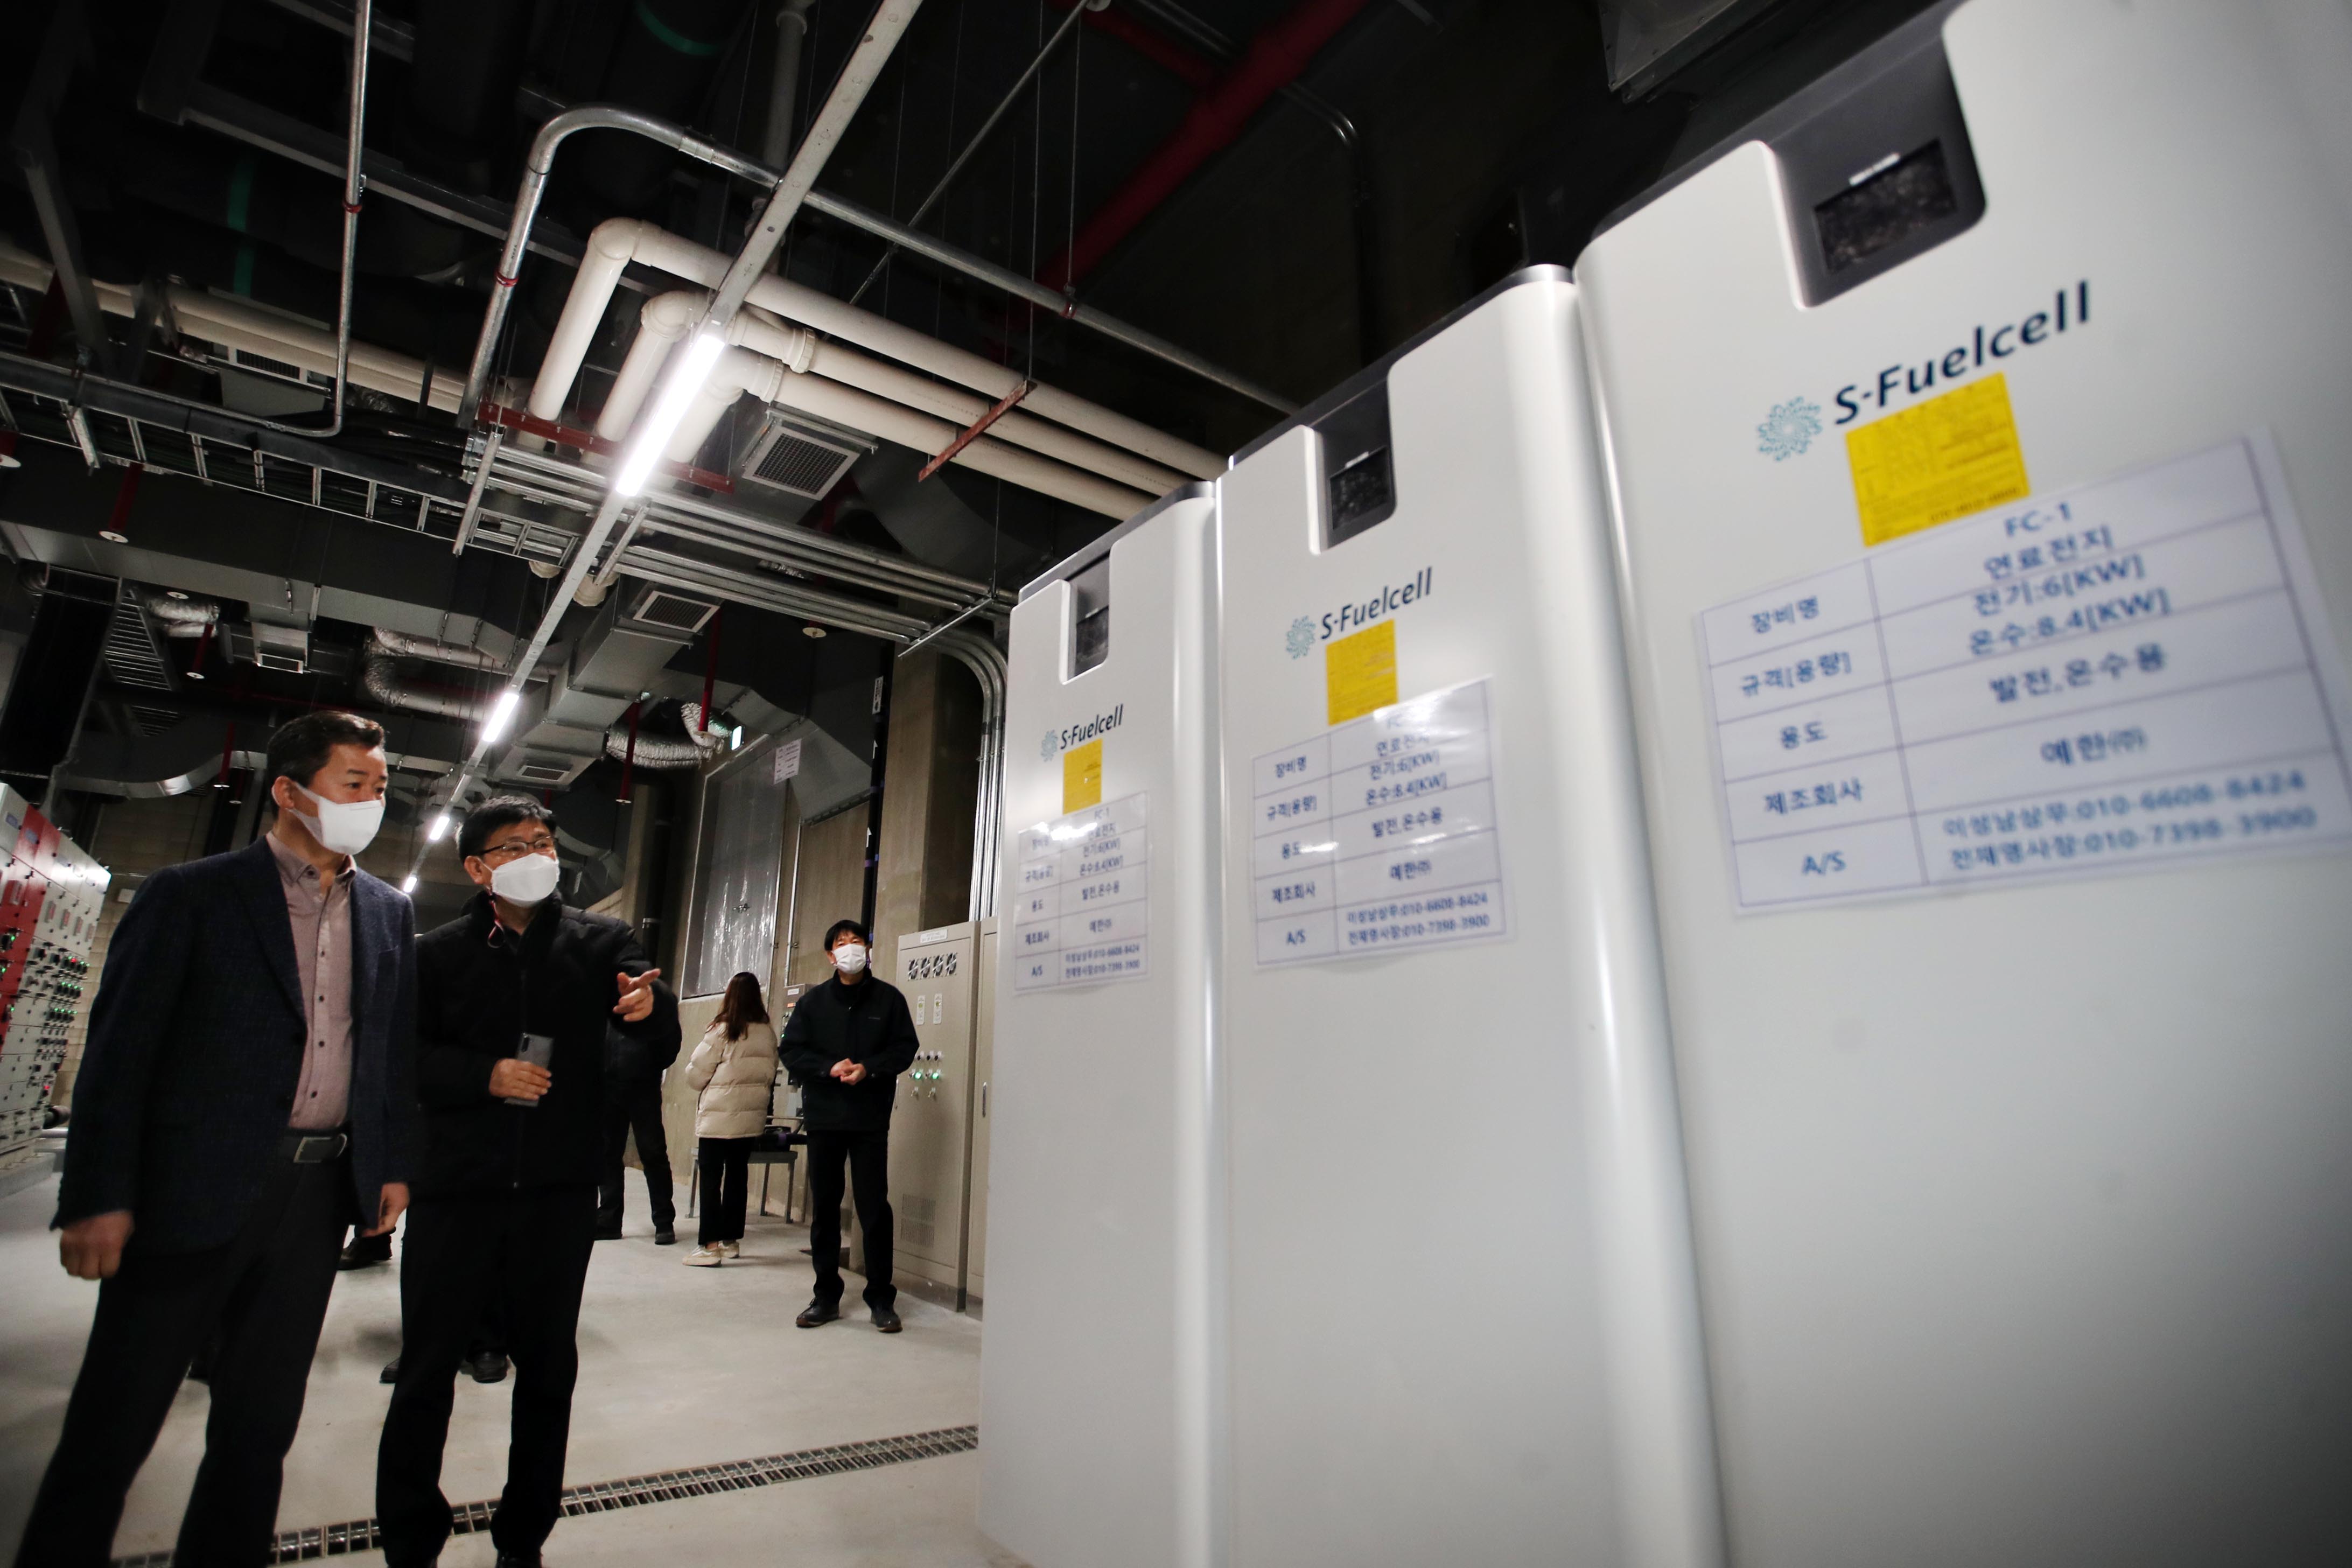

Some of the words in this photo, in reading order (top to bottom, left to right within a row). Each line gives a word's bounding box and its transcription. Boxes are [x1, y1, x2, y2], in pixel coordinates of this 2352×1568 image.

[1834, 279, 2090, 425] S-Fuelcell
[2004, 501, 2071, 537] FC-1
[1984, 525, 2113, 580] 연료전지
[1321, 565, 1432, 640] S-Fuelcell
[1751, 595, 1819, 634] 장비명
[1060, 703, 1123, 750] S-Fuelcell
[1780, 720, 1829, 750] 용도
[1275, 755, 1306, 778] 장비명
[1763, 776, 1863, 815] 제조회사
[1802, 850, 1847, 876] A/S
[1272, 881, 1316, 903] 제조회사
[1286, 930, 1306, 945] A/S
